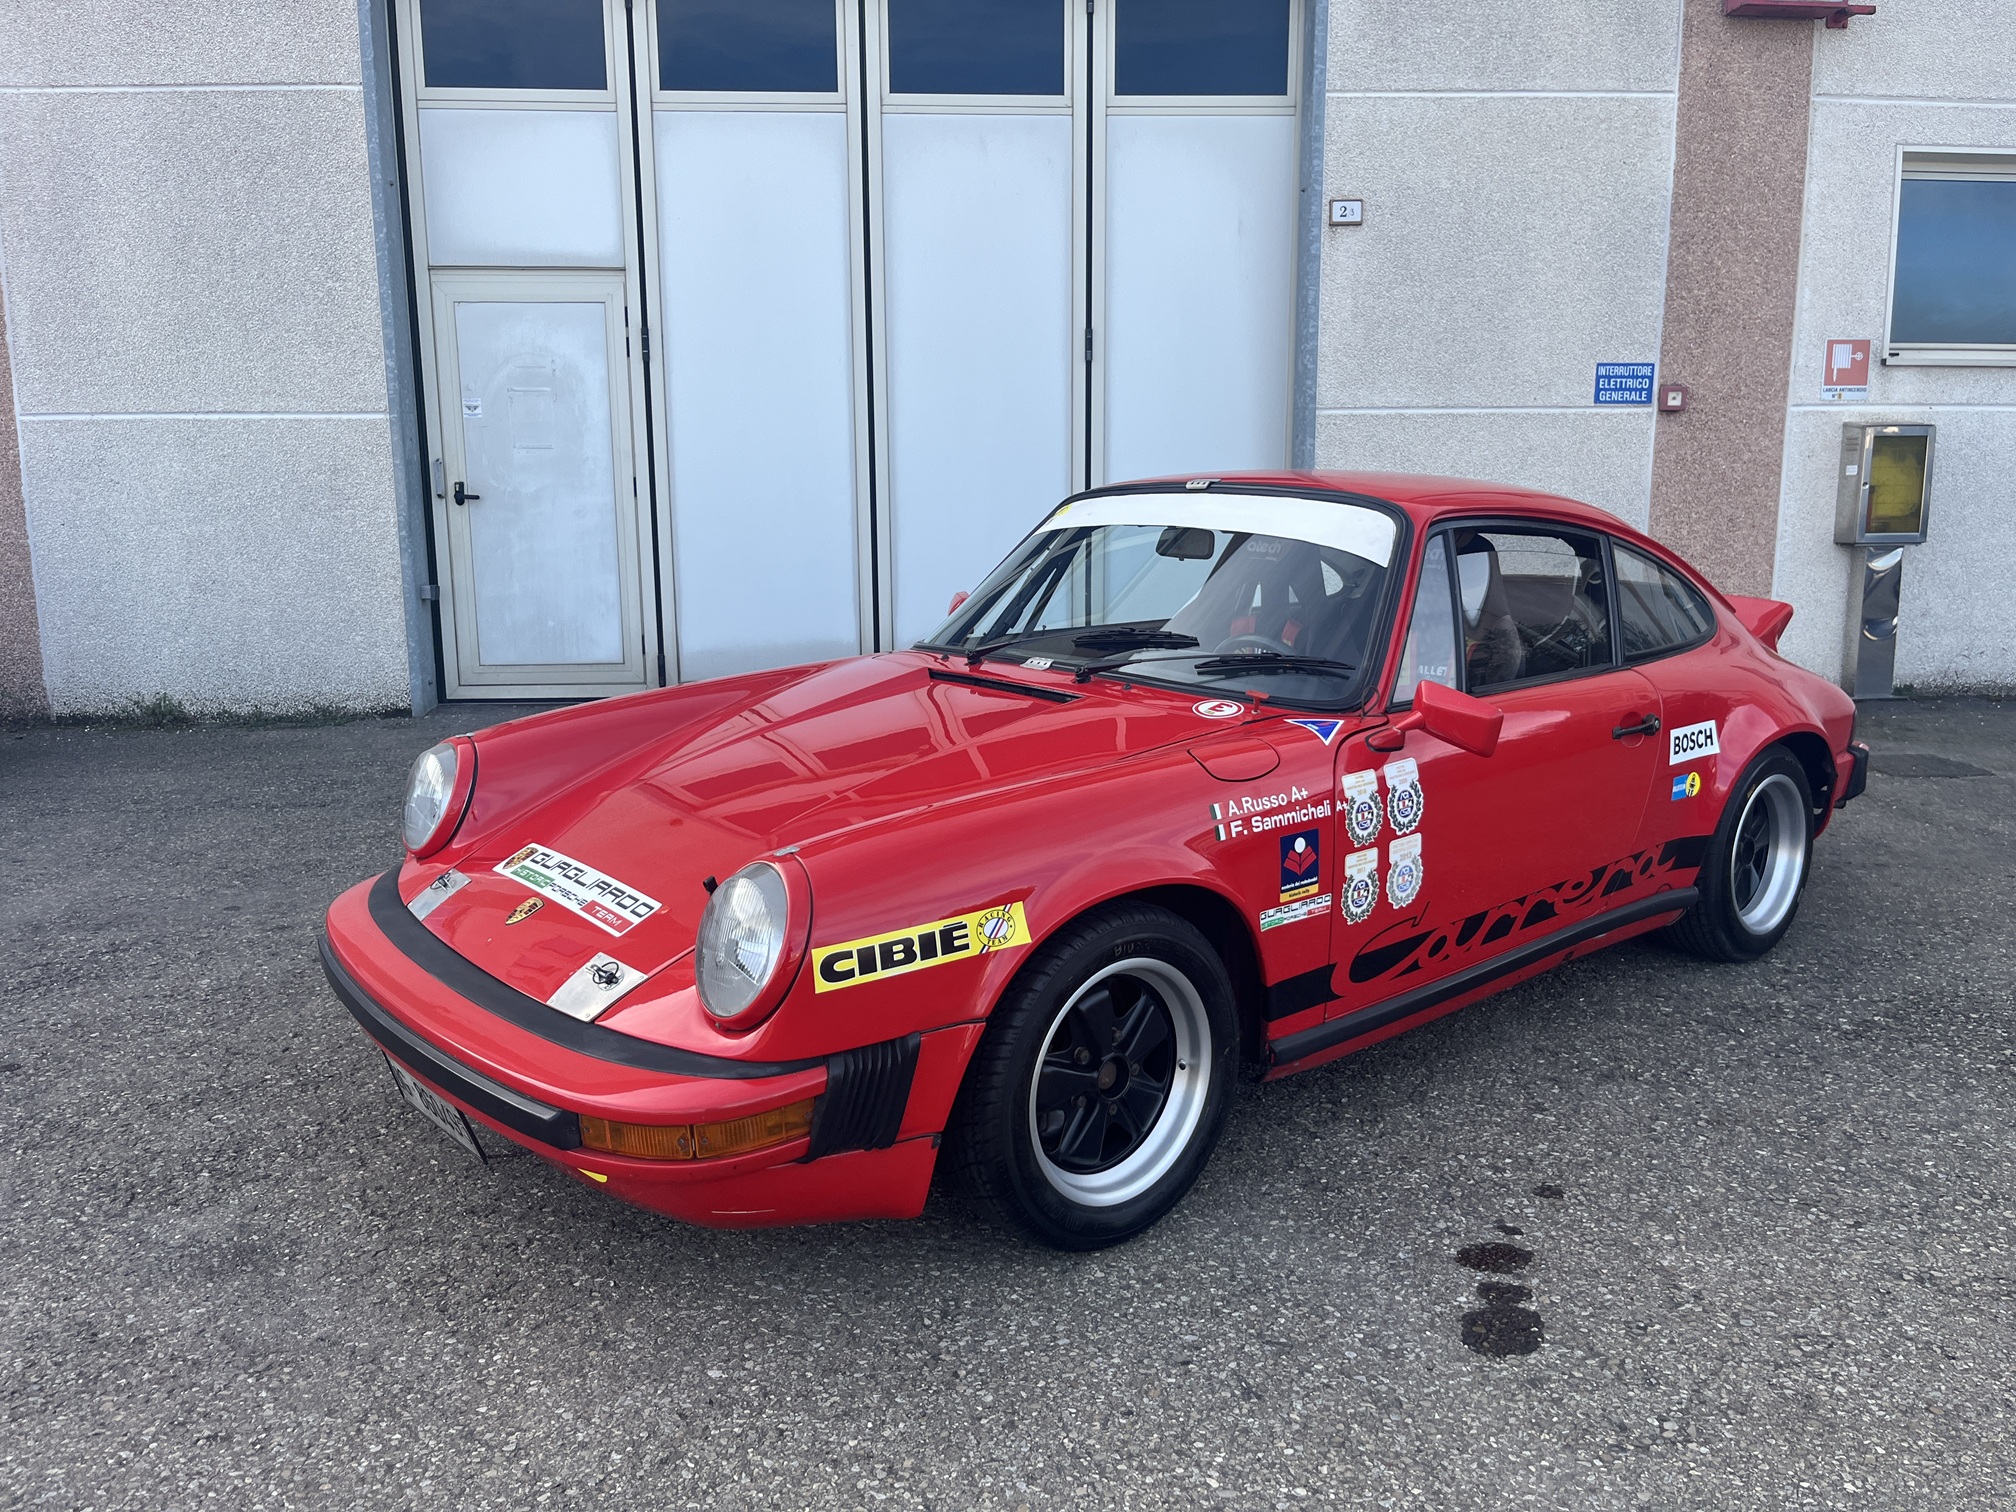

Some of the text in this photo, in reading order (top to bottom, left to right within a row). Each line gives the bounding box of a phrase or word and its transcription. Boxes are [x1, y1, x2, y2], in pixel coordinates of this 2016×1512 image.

[1597, 365, 1653, 376] INTERRUTTORE
[1599, 378, 1649, 389] ELETTRICO
[1599, 391, 1648, 401] GENERALE
[1209, 702, 1234, 713] E
[1673, 727, 1714, 756] BOSCH
[1228, 785, 1309, 817] A.Russo A+
[1229, 819, 1249, 839] F.
[1251, 800, 1332, 833] Sammicheli
[529, 851, 656, 919] GUAGLIARDO
[593, 905, 623, 928] TEAM
[978, 911, 1013, 929] RACING
[1330, 842, 1680, 999] Carrera
[987, 934, 1009, 947] TEAM
